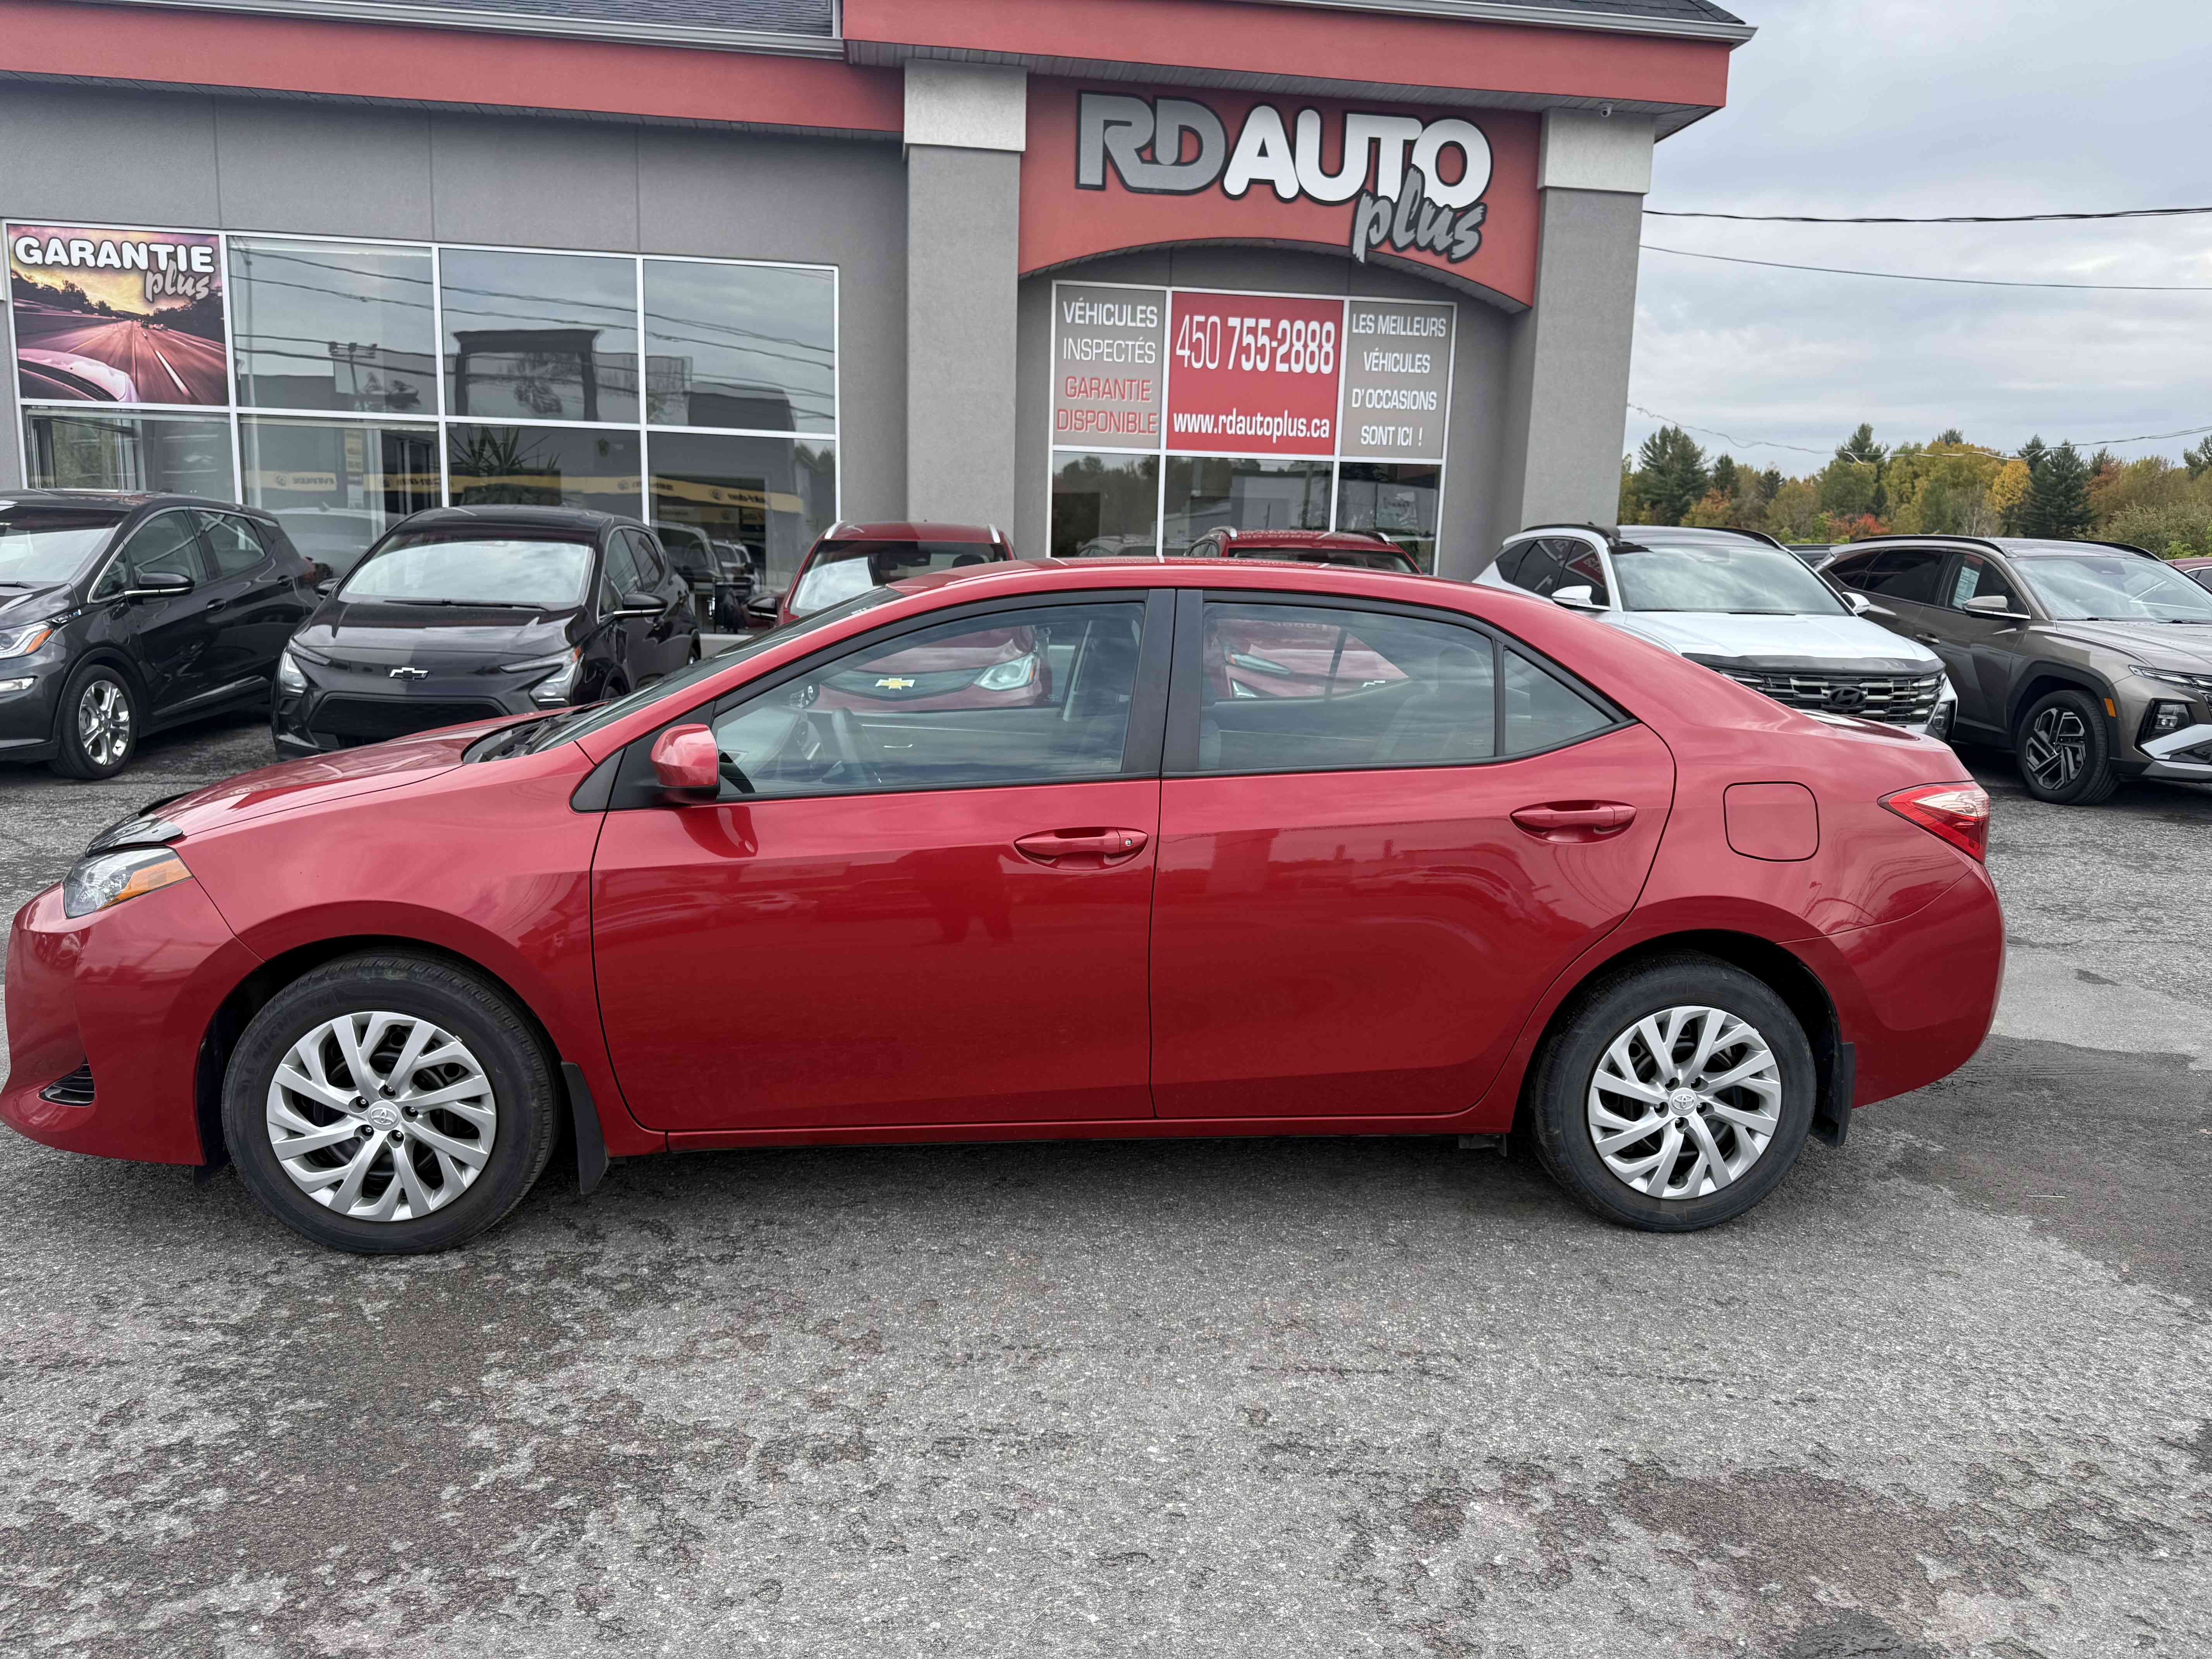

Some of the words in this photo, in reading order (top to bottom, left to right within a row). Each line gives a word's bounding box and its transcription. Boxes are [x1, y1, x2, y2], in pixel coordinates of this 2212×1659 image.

[1351, 164, 1487, 263] plus
[15, 237, 214, 273] GARANTIE
[145, 259, 210, 302] plus
[1063, 297, 1158, 328] VÉHICULES
[1352, 314, 1375, 334] LES
[1377, 315, 1446, 337] MEILLEURS
[1063, 337, 1156, 364] INSPECTÉS
[1176, 315, 1220, 369] 450
[1227, 317, 1335, 374] 755-2888
[1364, 348, 1430, 373] VÉHICULES
[1065, 376, 1152, 402] GARANTIE
[1352, 388, 1437, 410] D'OCCASIONS
[1057, 409, 1158, 435] DISPONIBLE
[1173, 408, 1329, 443] www.rdautoplus.ca
[1361, 426, 1395, 446] SONT
[1397, 427, 1413, 446] ICI
